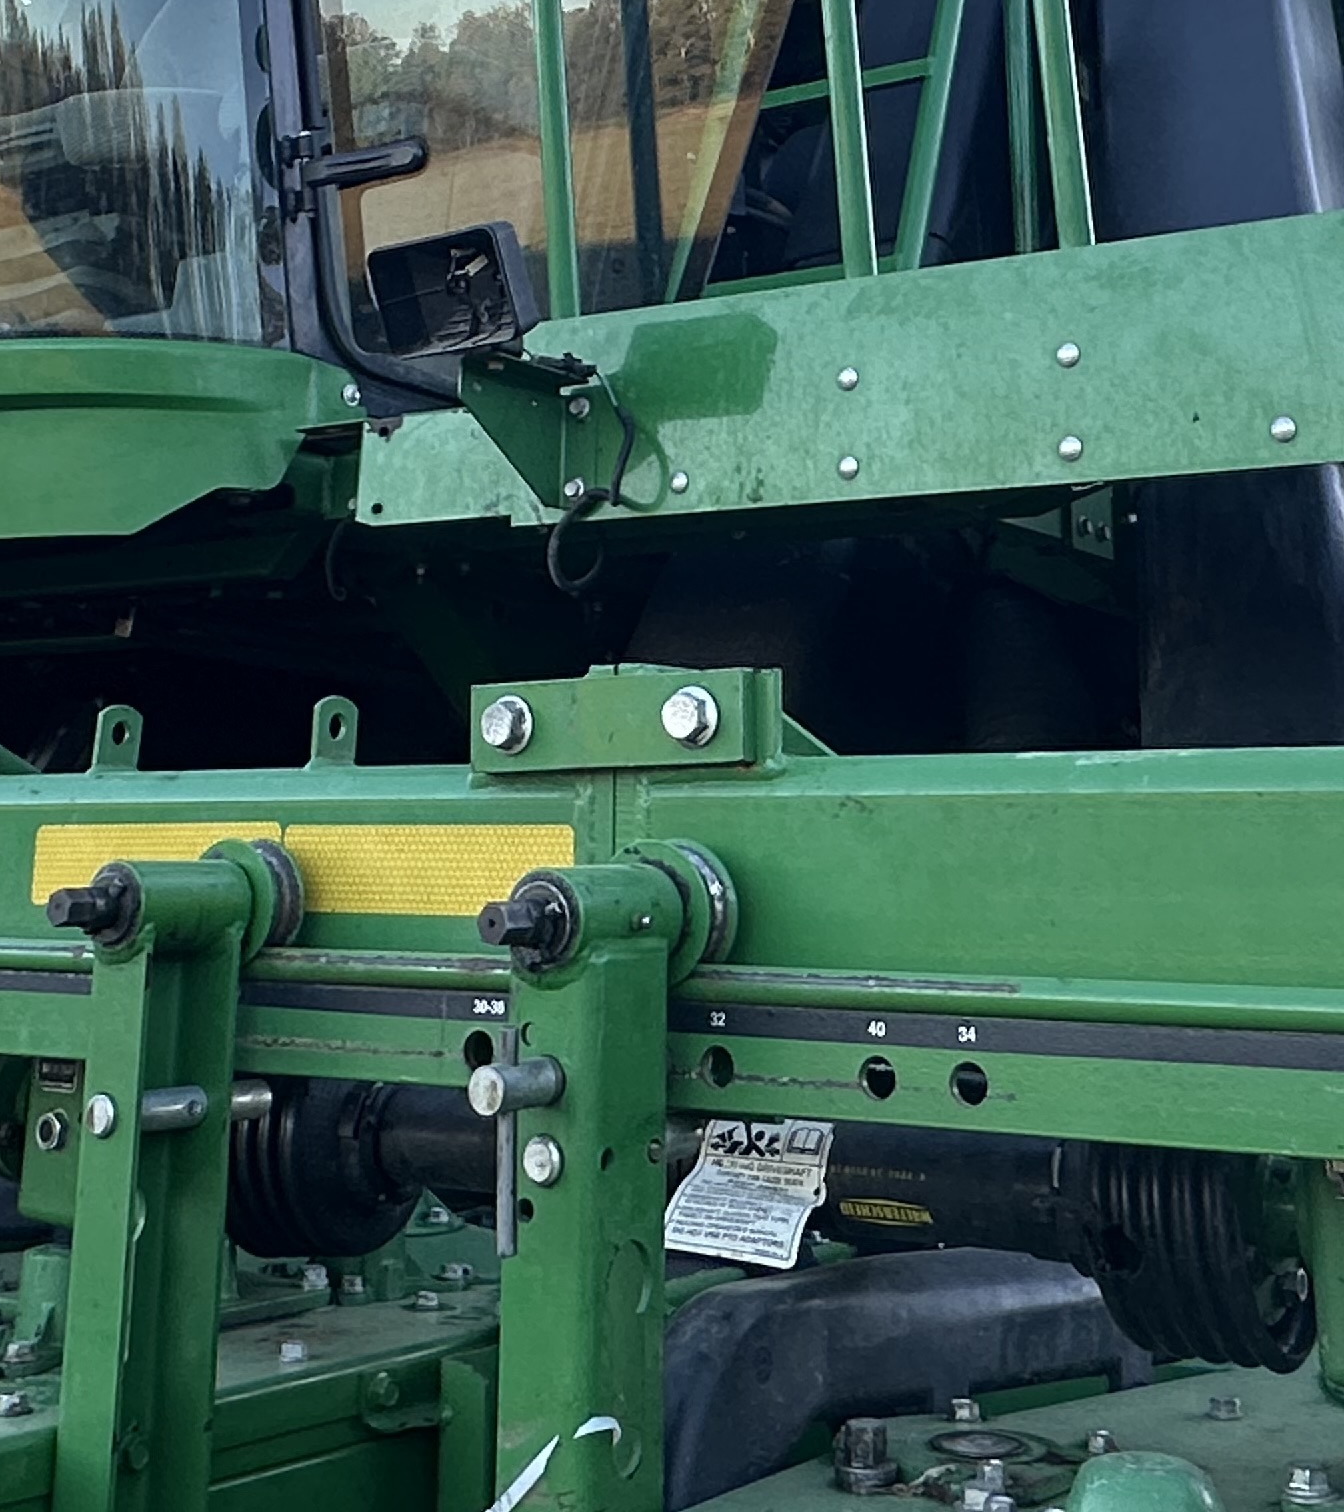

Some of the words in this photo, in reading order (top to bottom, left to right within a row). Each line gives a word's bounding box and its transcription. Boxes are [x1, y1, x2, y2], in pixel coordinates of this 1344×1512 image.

[709, 1011, 726, 1027] 32
[867, 1020, 886, 1037] 40
[957, 1026, 976, 1042] 34
